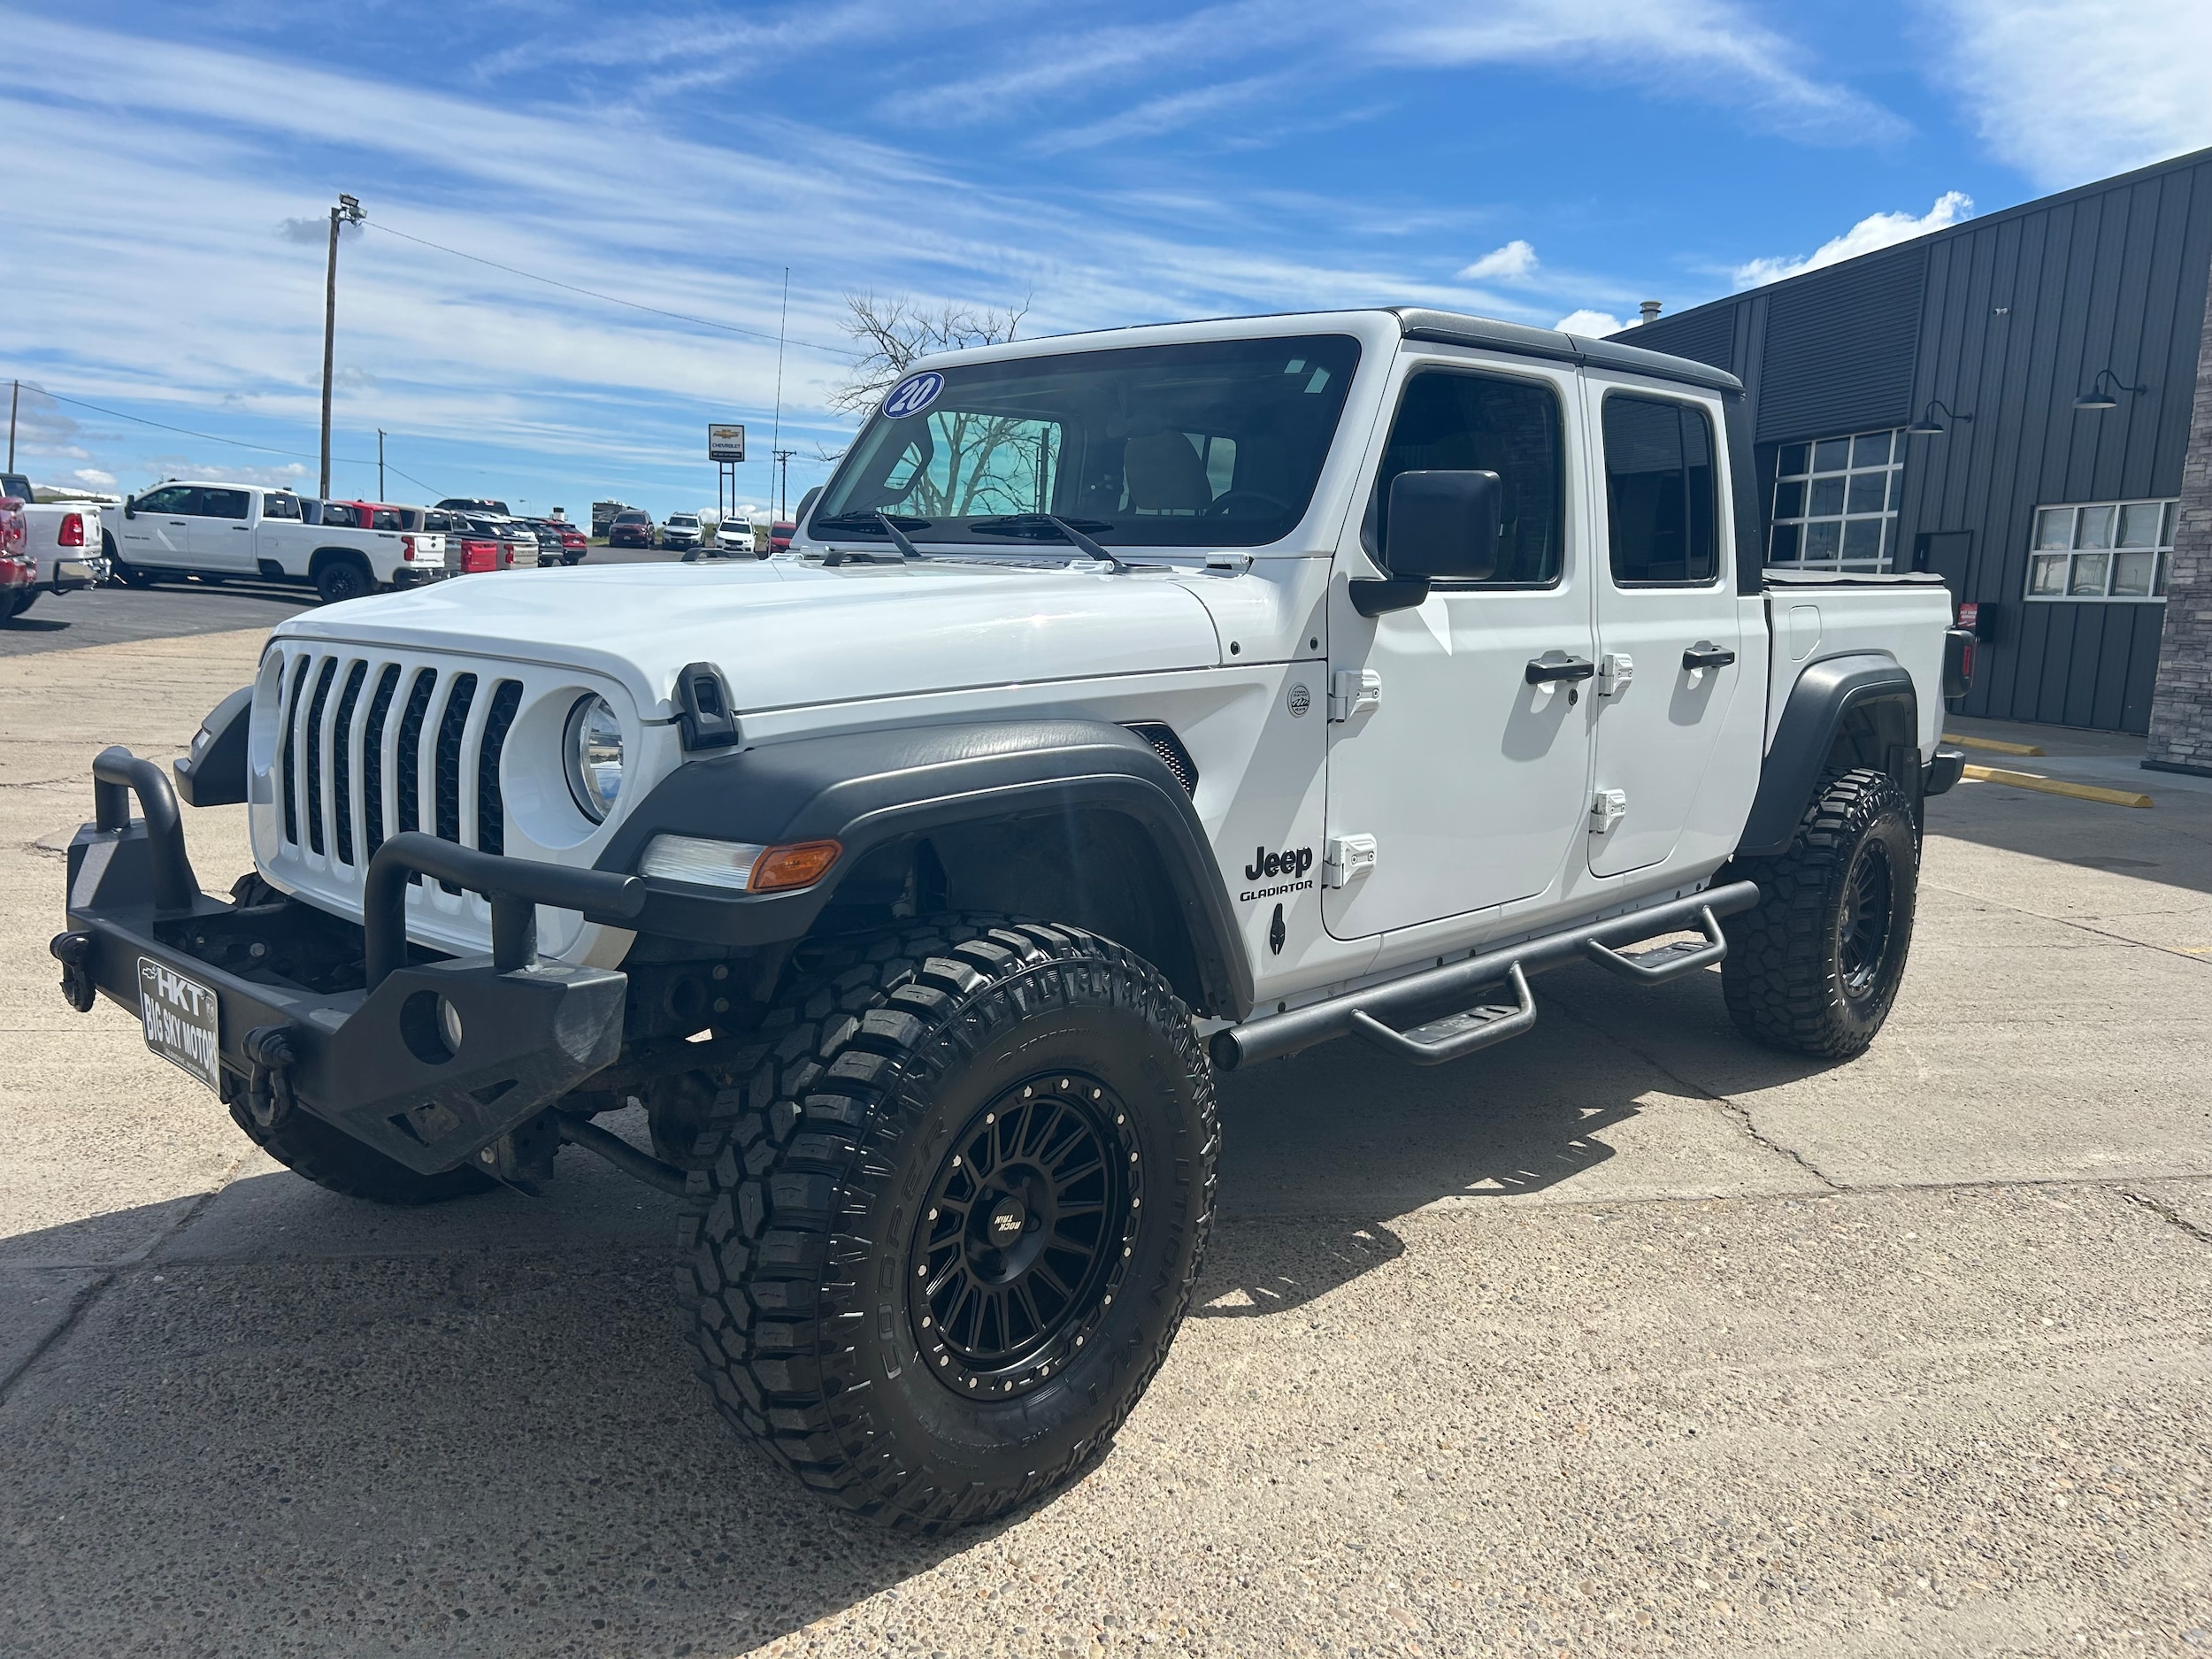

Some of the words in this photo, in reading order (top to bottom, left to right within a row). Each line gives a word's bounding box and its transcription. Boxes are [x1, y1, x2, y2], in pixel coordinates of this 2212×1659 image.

[888, 377, 936, 413] 20
[1245, 846, 1312, 880] Jeep
[1240, 879, 1313, 902] GLADIATOR
[157, 967, 200, 1017] HKT
[143, 992, 164, 1042] BIG
[163, 1008, 181, 1049] SKY
[182, 1021, 218, 1079] MOTORS
[1141, 1057, 1188, 1307] EVOLUTION
[877, 1116, 946, 1379] COOPER
[998, 1221, 1021, 1231] ROCK
